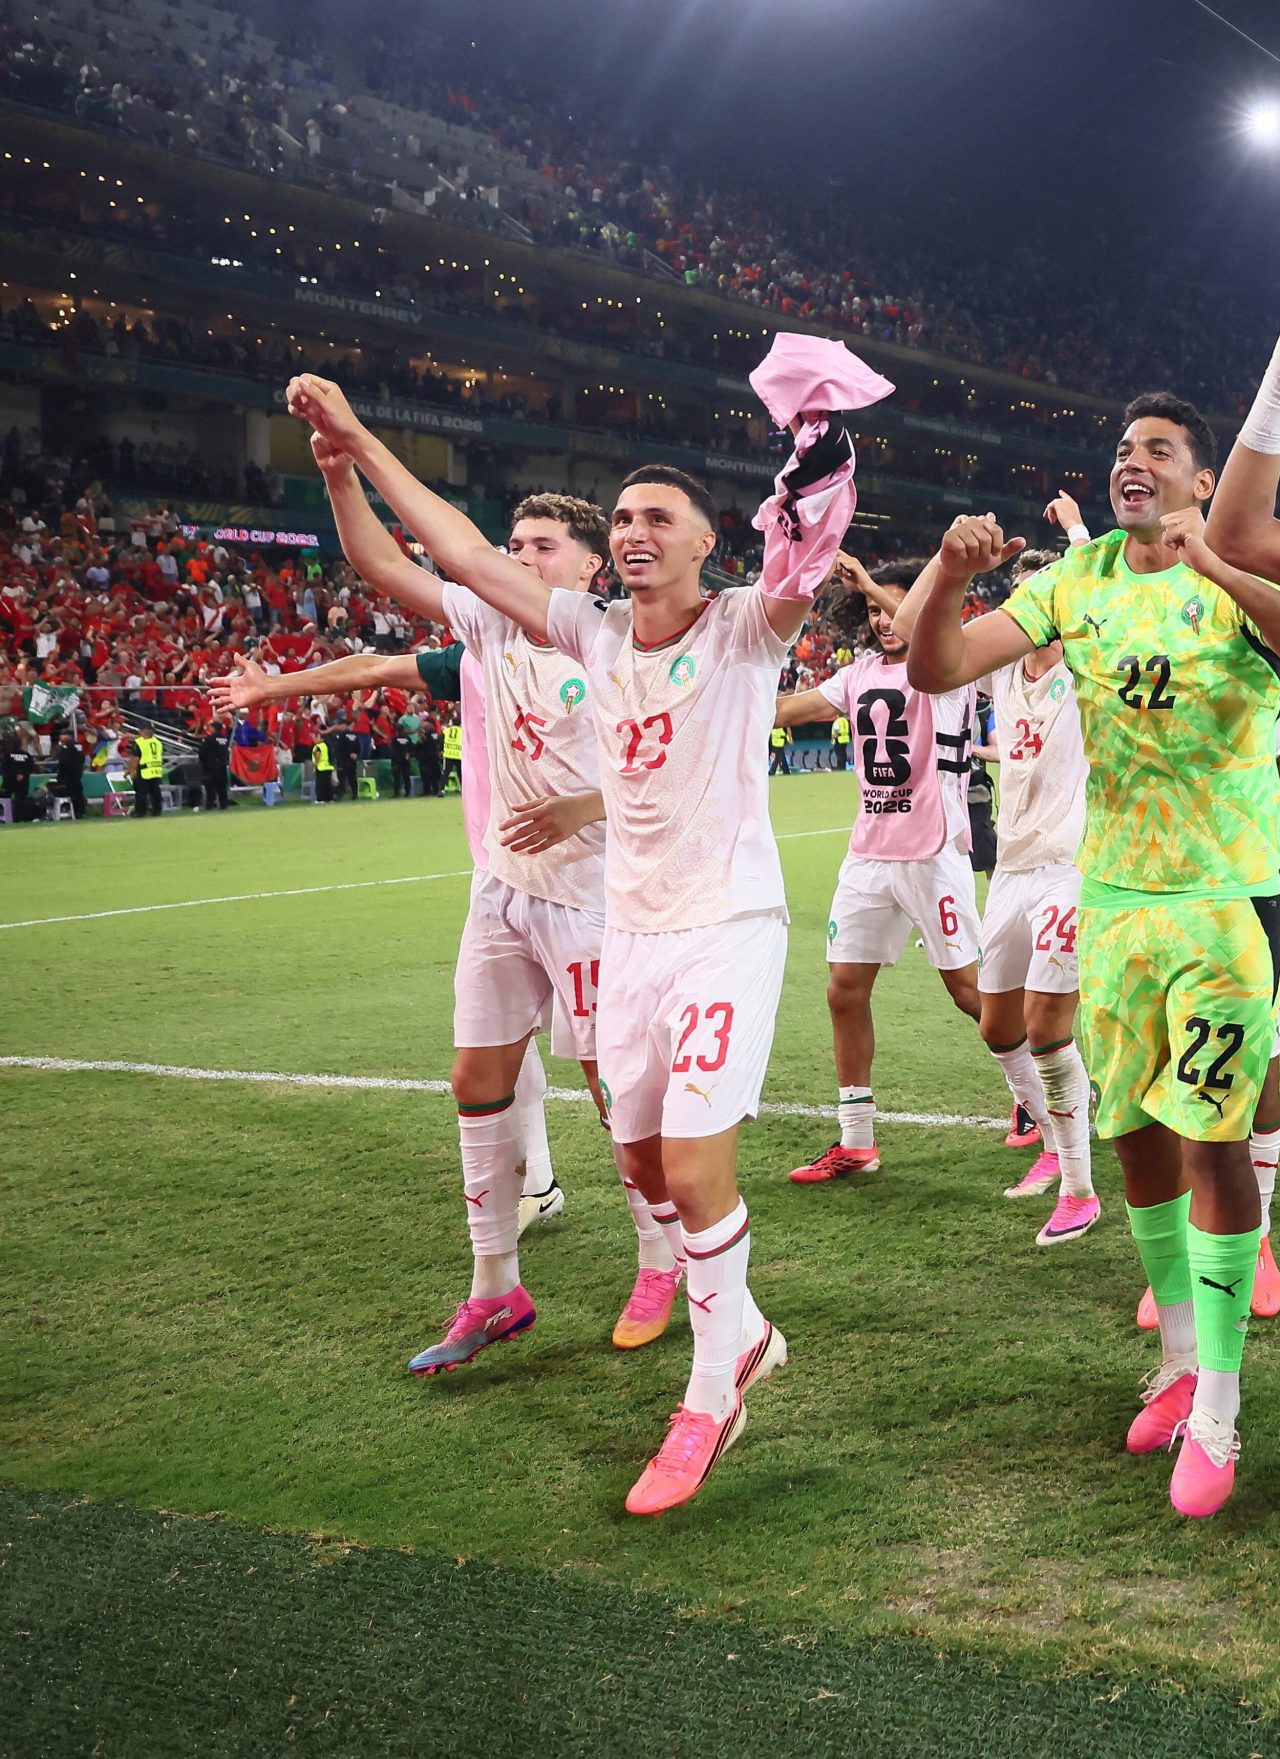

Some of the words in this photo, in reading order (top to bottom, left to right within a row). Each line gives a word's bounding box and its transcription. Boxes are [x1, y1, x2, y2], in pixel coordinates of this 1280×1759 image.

[295, 289, 422, 324] MONTERREY
[413, 411, 439, 426] FIFA
[442, 416, 483, 432] 2026
[214, 527, 249, 542] ORLD
[250, 529, 275, 543] CUP
[1117, 655, 1176, 709] 22
[616, 711, 674, 775] 23
[872, 766, 896, 778] FIFA
[863, 789, 890, 799] WORLD
[890, 788, 913, 798] CUP
[864, 799, 912, 814] 2026
[938, 895, 959, 937] 6
[1035, 904, 1077, 953] 24
[671, 1001, 735, 1073] 23
[1177, 1016, 1245, 1090] 22
